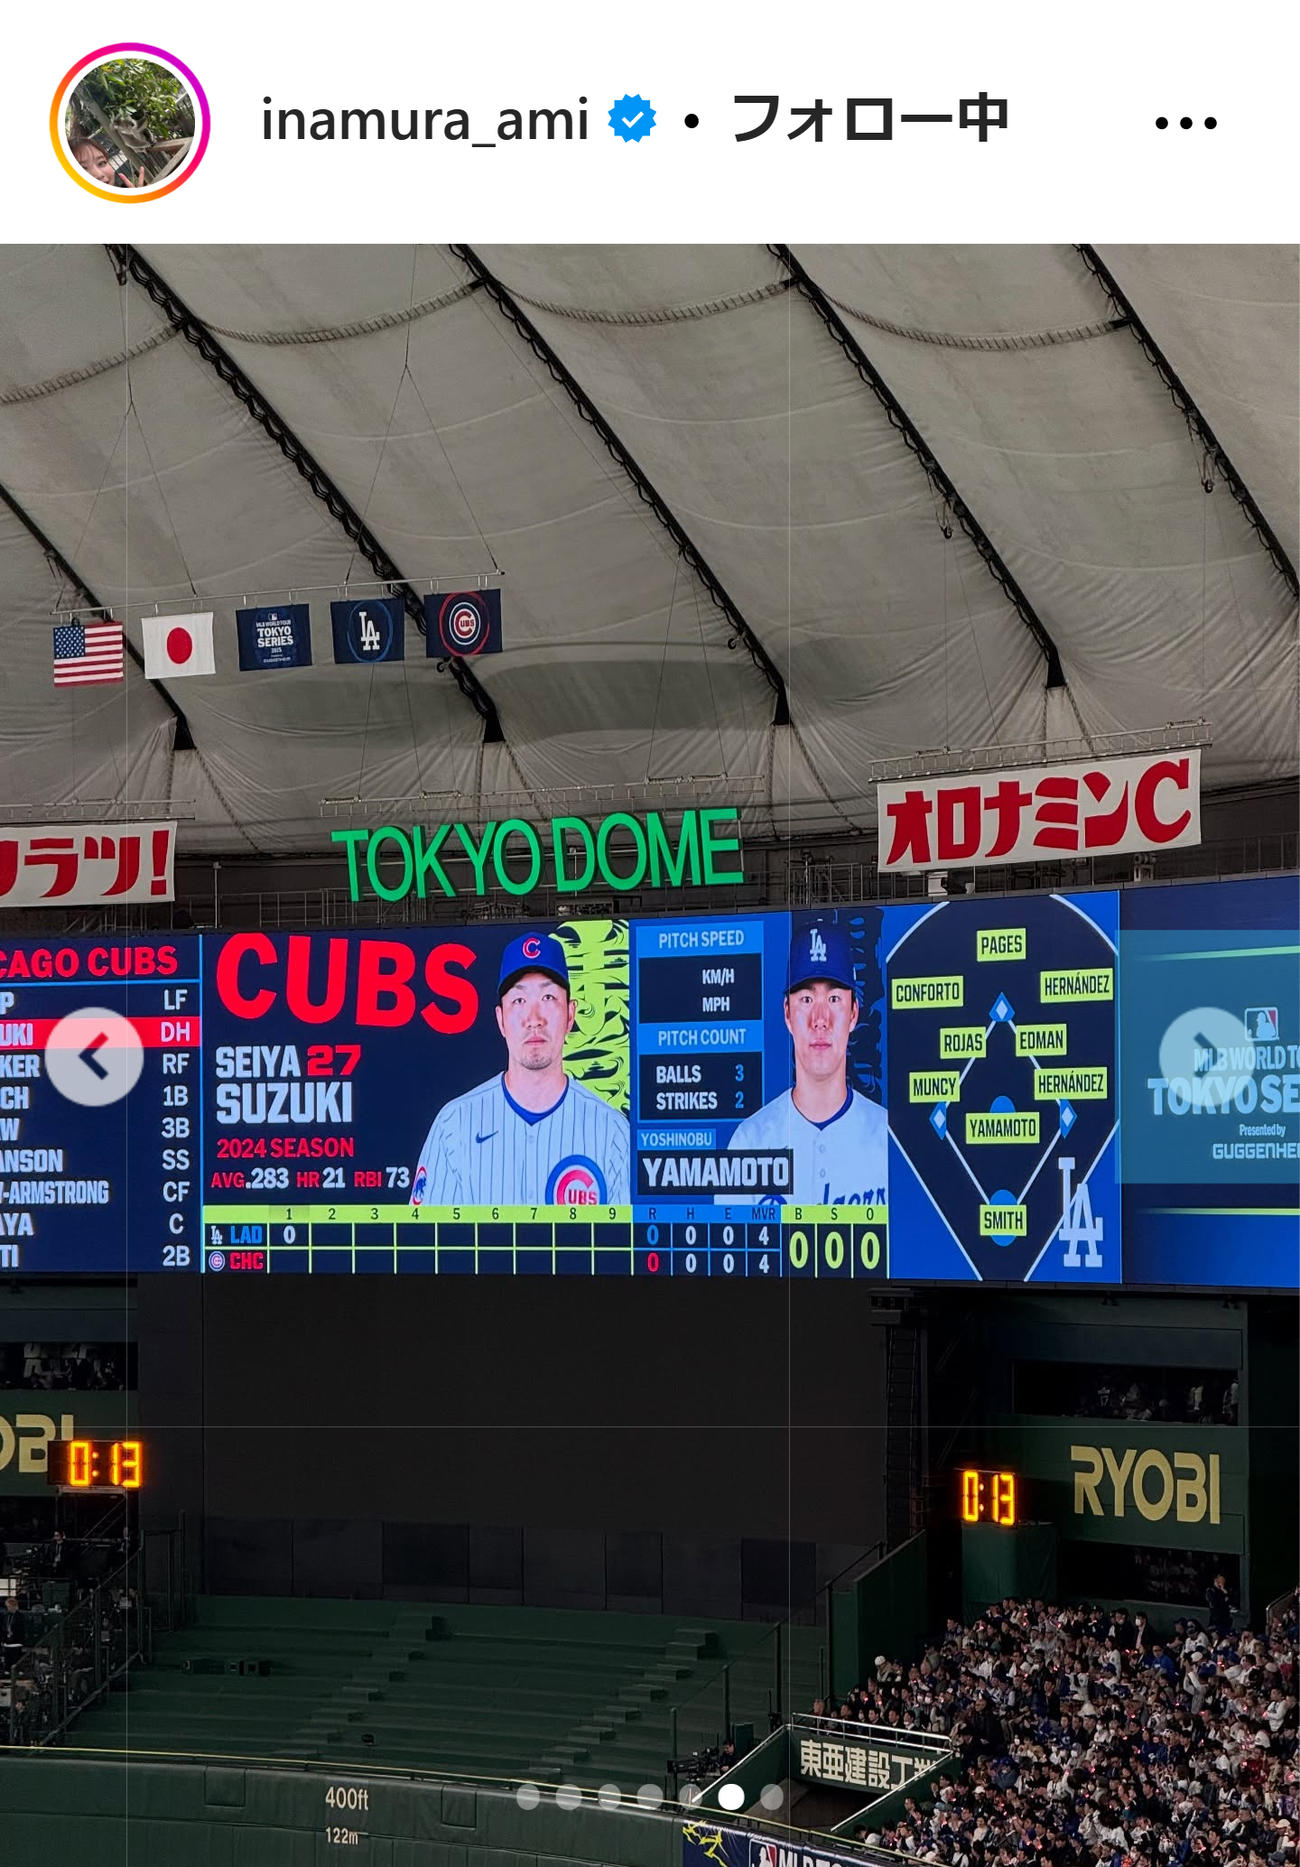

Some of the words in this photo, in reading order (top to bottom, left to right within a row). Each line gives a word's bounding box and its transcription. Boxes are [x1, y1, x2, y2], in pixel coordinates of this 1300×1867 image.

[257, 626, 291, 637] TOKYO
[257, 635, 294, 648] SERIES
[358, 611, 380, 651] LA
[886, 758, 1192, 865] オロナミンC
[331, 818, 542, 902] TOKYO
[552, 808, 744, 893] DOME
[659, 932, 698, 949] PITCH
[700, 929, 745, 947] SPEED
[810, 928, 827, 962] LA
[981, 934, 1022, 956] PAGES
[87, 946, 178, 977] CUBS
[216, 932, 479, 1035] CUBS
[702, 968, 735, 985] KM/H
[1044, 971, 1110, 995] HERNÁNDEZ
[164, 990, 188, 1011] LF
[896, 982, 960, 1003] CONFORTO
[702, 996, 730, 1013] MPH
[161, 1021, 191, 1043] DH
[658, 1030, 697, 1047] PITCH
[700, 1028, 746, 1046] COUNT
[944, 1032, 983, 1053] ROJAS
[1020, 1028, 1064, 1050] EDMAN
[162, 1053, 189, 1075] RF
[216, 1045, 301, 1079] SEIYA
[307, 1044, 361, 1076] 27
[1194, 1048, 1227, 1072] MLB
[1229, 1046, 1286, 1070] WORLD
[656, 1064, 702, 1083] BALLS
[735, 1063, 744, 1081] 3
[1038, 1070, 1104, 1095] HERNÁNDEZ
[163, 1084, 188, 1107] 1B
[913, 1076, 956, 1097] MUNCY
[1147, 1075, 1258, 1115] TOKYO
[1260, 1074, 1300, 1114] SE
[216, 1081, 352, 1125] SUZUKI
[656, 1091, 718, 1111] STRIKES
[735, 1091, 744, 1109] 2
[161, 1116, 190, 1139] 3B
[970, 1117, 1036, 1138] YAMAMOTO
[1239, 1124, 1275, 1136] Presented
[1276, 1124, 1286, 1138] by
[216, 1138, 267, 1158] 2024
[270, 1137, 354, 1158] SEASON
[641, 1132, 712, 1147] YOSHINOBU
[162, 1149, 190, 1171] SS
[211, 1172, 245, 1188] AVG
[245, 1167, 289, 1189] .283
[297, 1171, 320, 1187] HR
[322, 1167, 346, 1188] 21
[354, 1171, 382, 1187] RBI
[386, 1167, 410, 1188] 73
[642, 1157, 789, 1187] YAMAMOTO
[163, 1181, 191, 1203] CF
[286, 1208, 293, 1220] 1
[328, 1208, 336, 1220] 2
[371, 1208, 379, 1220] 3
[411, 1208, 419, 1220] 4
[453, 1208, 461, 1220] 5
[492, 1208, 499, 1220] 6
[531, 1208, 538, 1220] 7
[569, 1208, 577, 1220] 8
[609, 1208, 616, 1220] 9
[649, 1208, 656, 1220] R
[687, 1208, 694, 1220] H
[725, 1208, 731, 1220] E
[752, 1208, 775, 1220] MVR
[795, 1208, 802, 1220] B
[831, 1208, 838, 1220] S
[984, 1209, 1024, 1231] SMITH
[1058, 1157, 1104, 1267] LA
[169, 1213, 184, 1235] C
[231, 1226, 263, 1244] LAD
[283, 1226, 296, 1244] 0
[647, 1226, 659, 1244] 0
[685, 1226, 697, 1244] 0
[723, 1226, 734, 1244] 0
[758, 1226, 769, 1244] 4
[162, 1246, 190, 1267] 2B
[789, 1231, 809, 1269] 0
[825, 1231, 844, 1269] 0
[860, 1231, 880, 1269] 0
[230, 1252, 264, 1269] CHC
[647, 1253, 659, 1272] 0
[685, 1253, 697, 1272] 0
[723, 1253, 734, 1272] 0
[758, 1253, 769, 1272] 4
[70, 1441, 141, 1487] 0:13
[1070, 1445, 1220, 1524] RYOBI
[962, 1470, 1016, 1527] 0:13
[326, 1786, 368, 1811] 400ft
[326, 1827, 358, 1845] 122m
